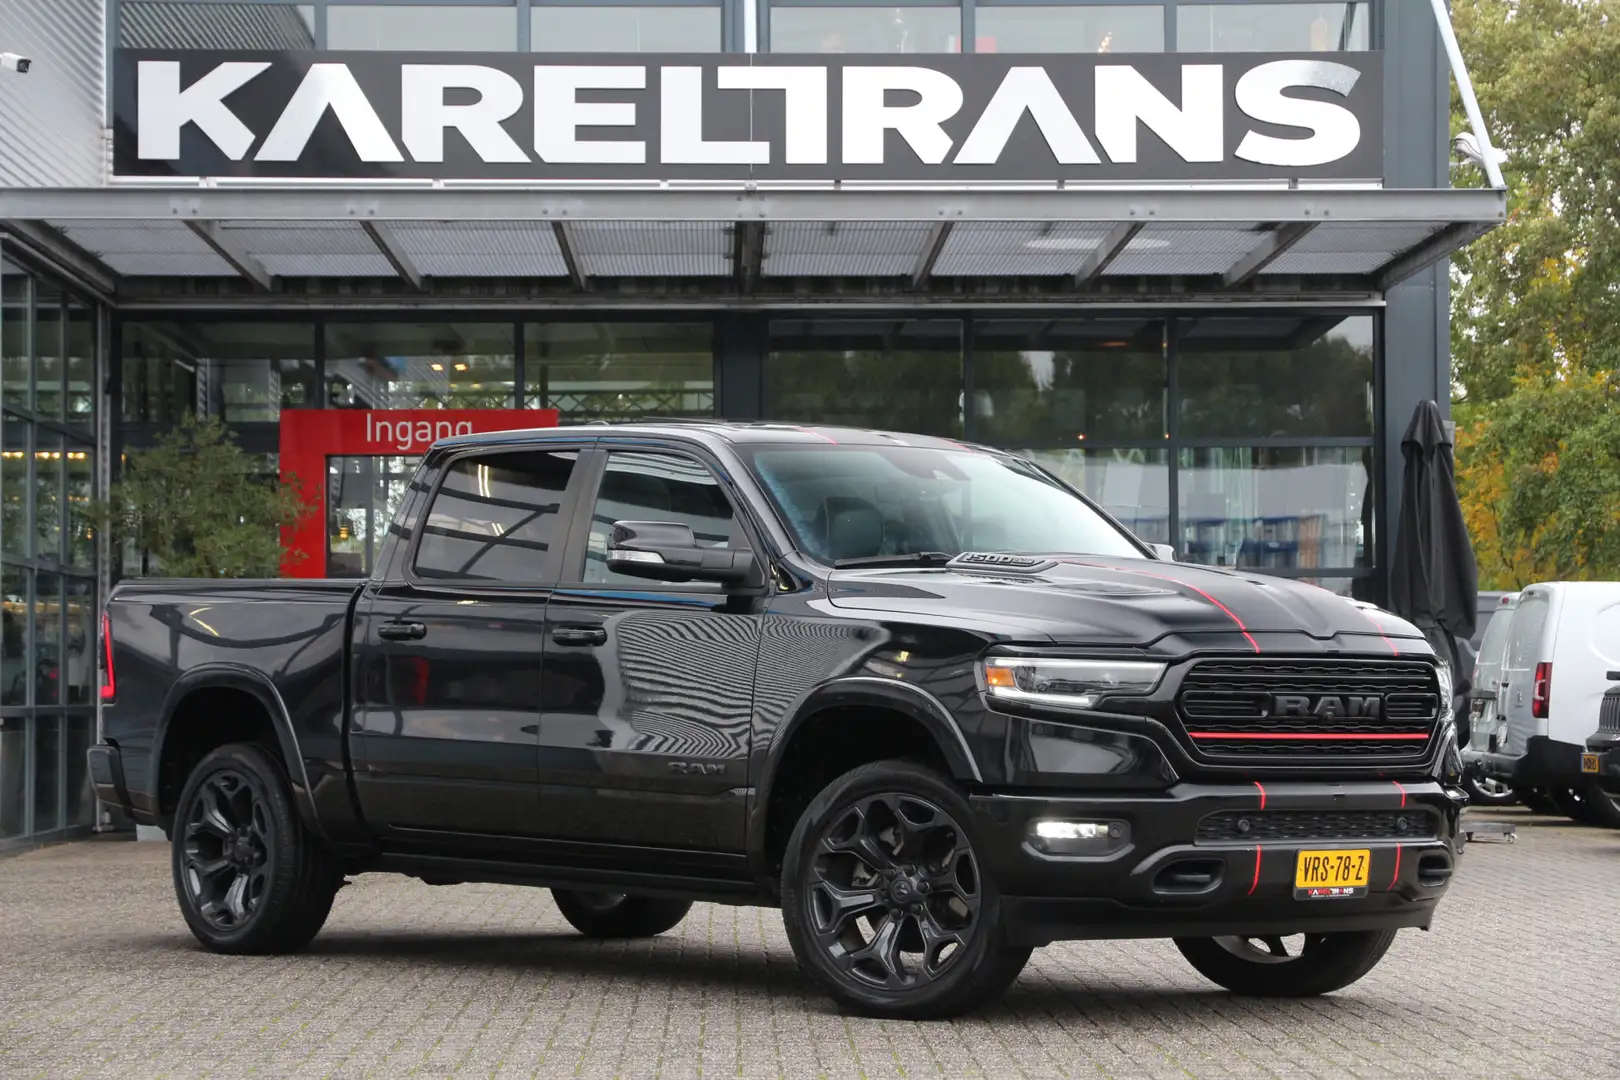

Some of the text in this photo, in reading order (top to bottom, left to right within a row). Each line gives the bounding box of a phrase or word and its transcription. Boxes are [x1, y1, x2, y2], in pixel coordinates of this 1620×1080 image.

[137, 60, 1362, 167] KARELTRANS
[1274, 695, 1381, 717] RAM
[667, 761, 726, 775] RAM
[1303, 855, 1365, 882] VRS-78-Z
